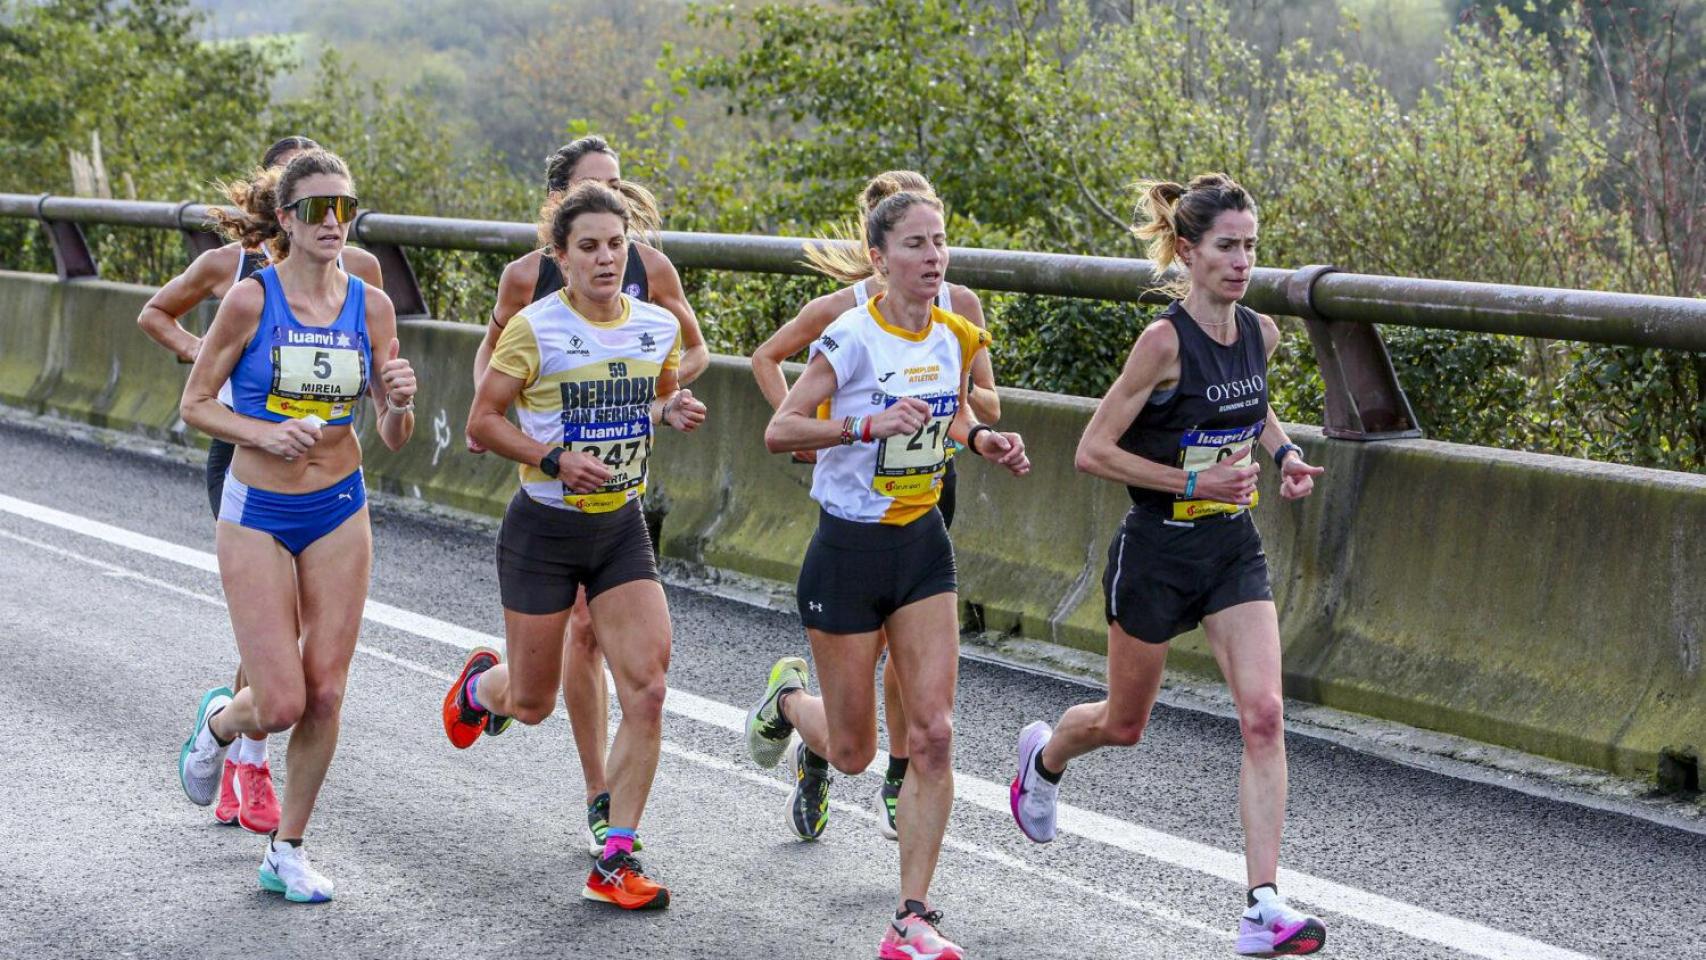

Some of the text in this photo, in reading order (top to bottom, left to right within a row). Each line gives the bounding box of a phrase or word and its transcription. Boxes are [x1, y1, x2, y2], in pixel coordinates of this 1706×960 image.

[288, 330, 334, 345] luanvi
[313, 351, 332, 379] 5
[608, 362, 627, 378] 59
[301, 383, 341, 394] MIREIA
[560, 376, 657, 410] BEHOBI
[1206, 375, 1264, 402] OYSHO
[1218, 398, 1259, 413] RUNNING CLUB
[580, 423, 628, 439] luanvi
[906, 421, 941, 451] 21
